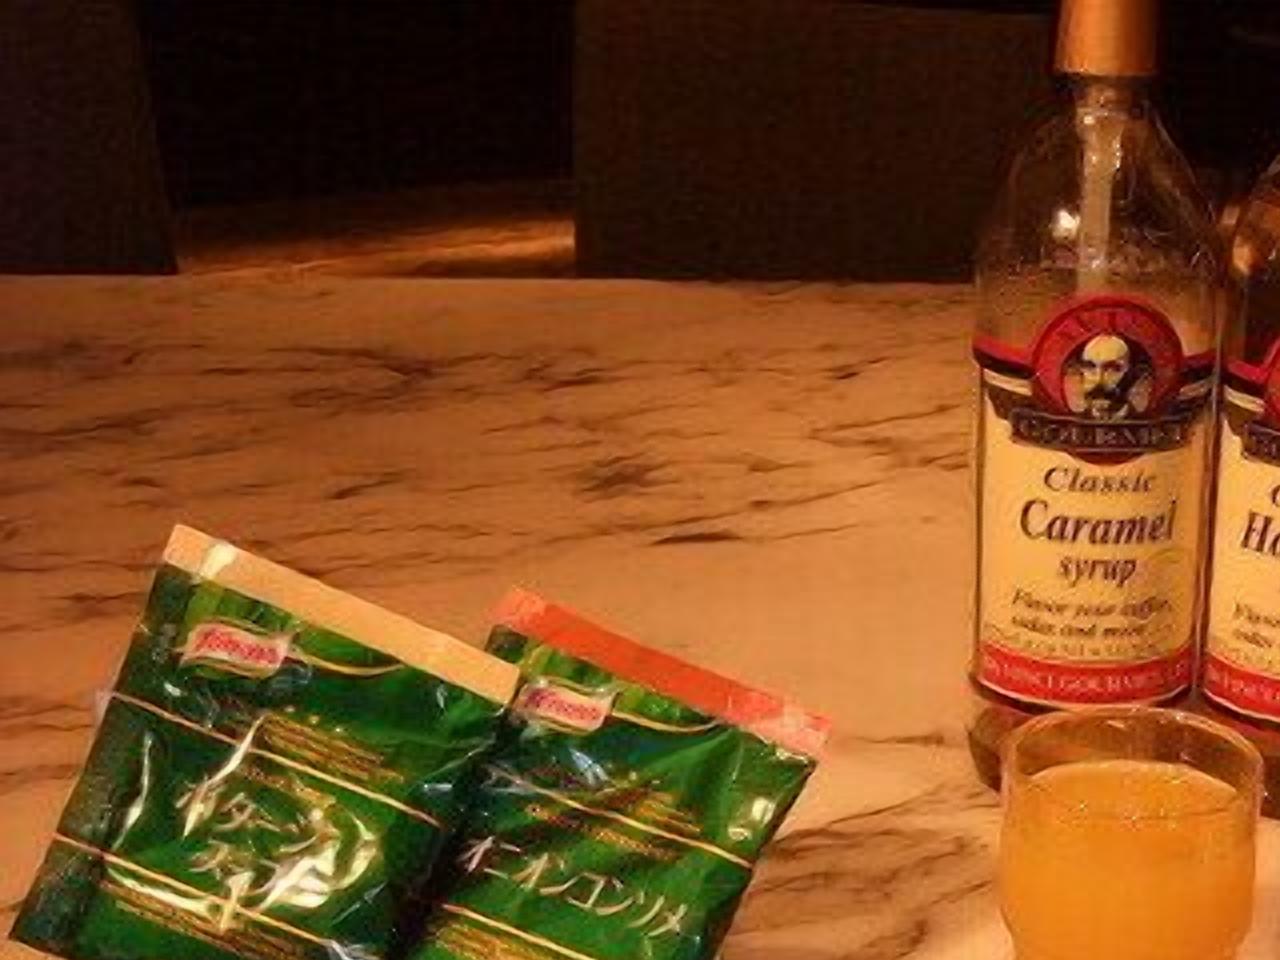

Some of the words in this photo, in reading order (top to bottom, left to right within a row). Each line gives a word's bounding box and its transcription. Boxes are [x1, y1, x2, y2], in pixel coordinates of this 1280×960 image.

[1044, 467, 1156, 494] Classic
[1019, 498, 1179, 545] Caramel
[1057, 555, 1137, 587] syrup
